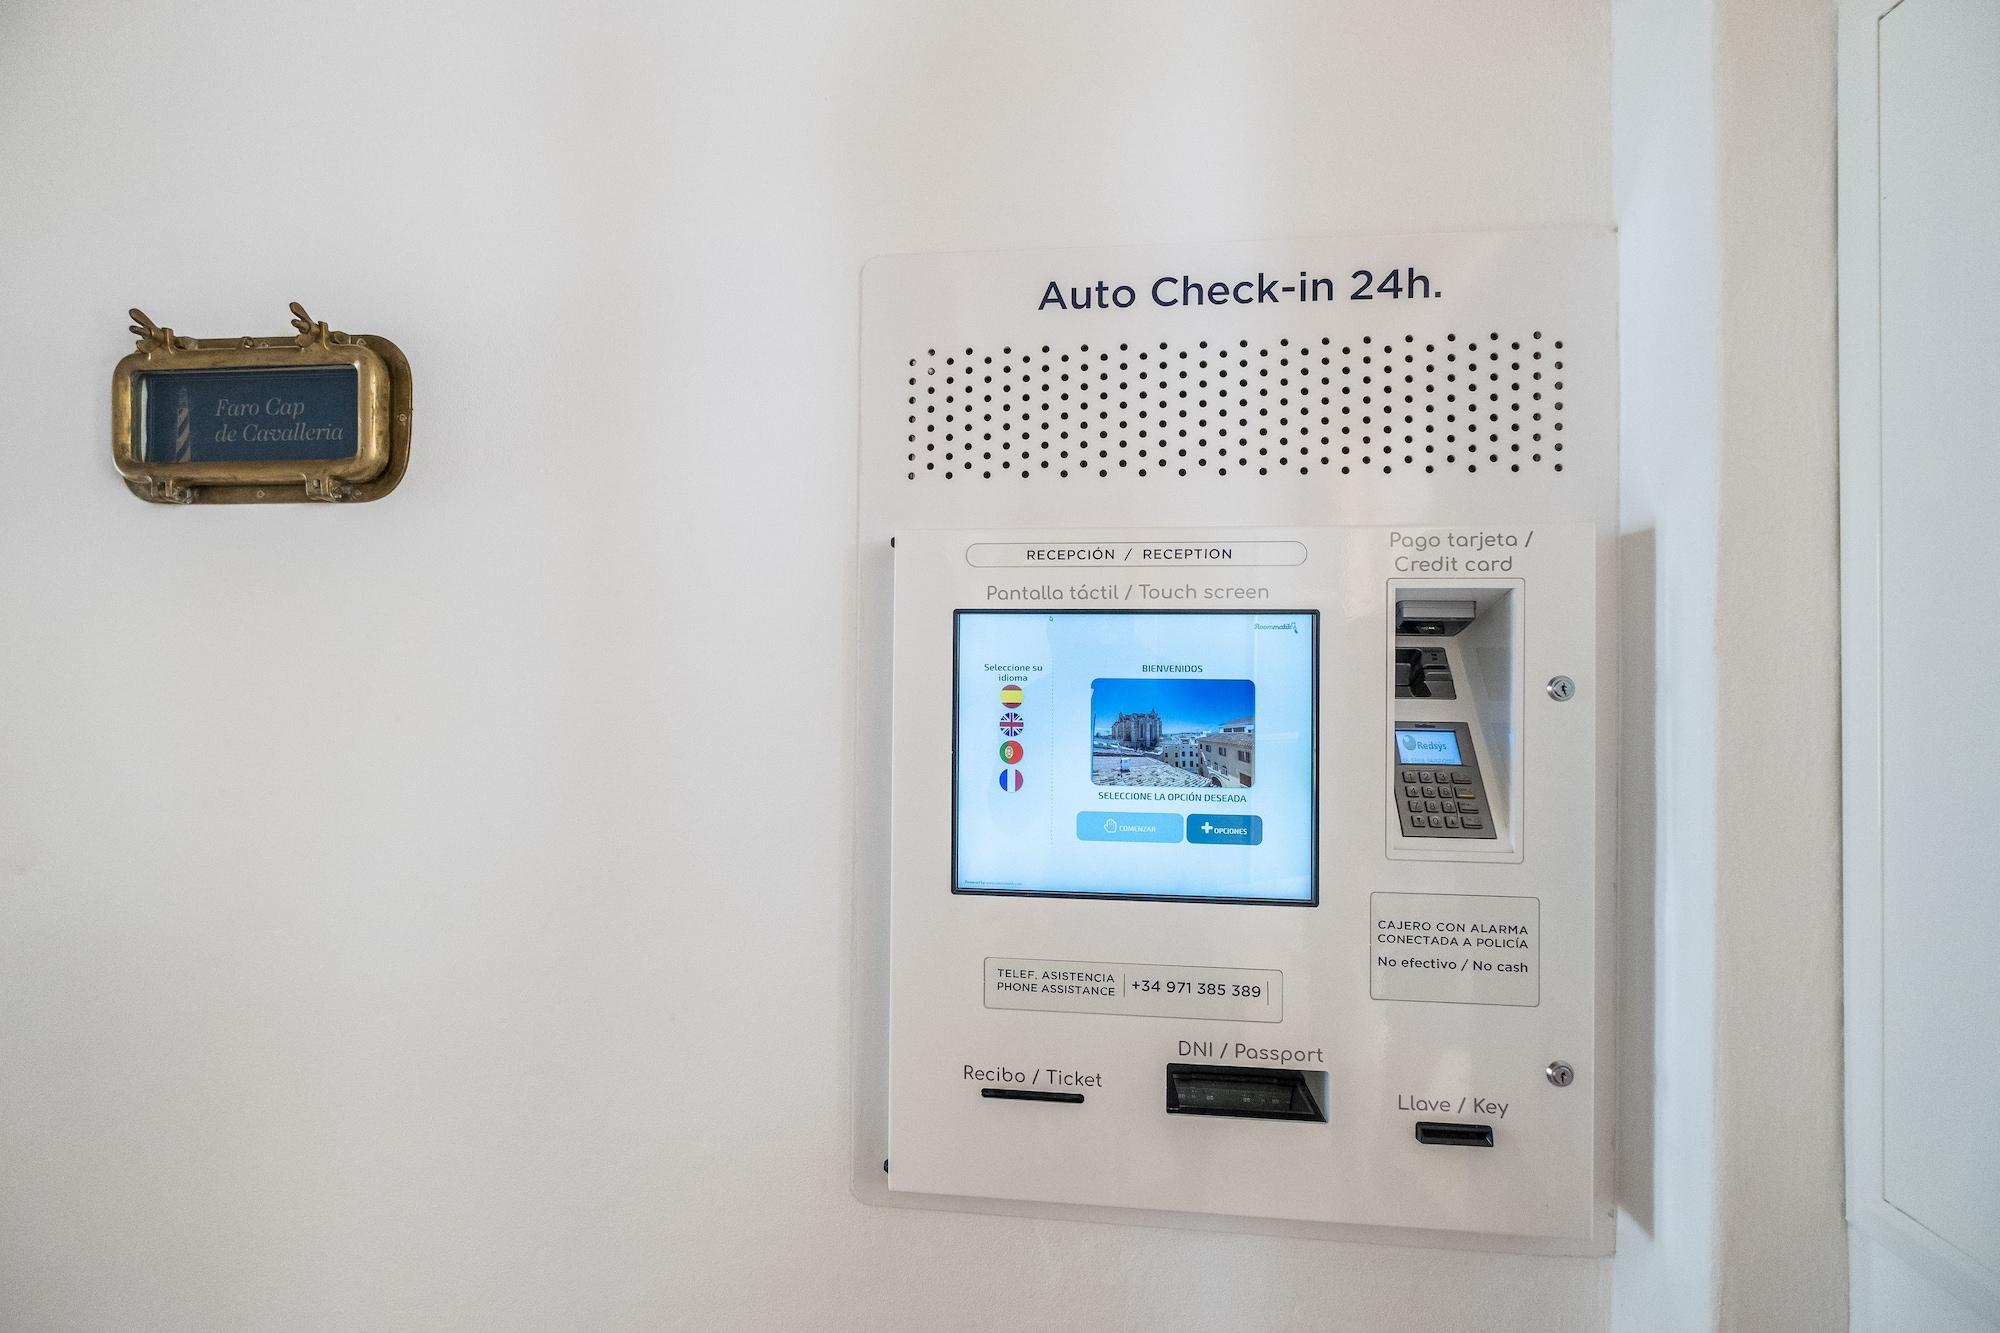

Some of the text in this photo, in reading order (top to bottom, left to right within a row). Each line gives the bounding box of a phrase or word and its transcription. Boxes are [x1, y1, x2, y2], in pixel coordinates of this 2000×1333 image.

[1038, 267, 1442, 310] Auto Check-in 24h.
[215, 397, 304, 419] Faro Cap
[215, 423, 344, 442] de Cavalleria
[1390, 532, 1440, 550] Pago
[1448, 532, 1518, 550] tarjeta
[1026, 547, 1115, 561] RECEPCIÓN
[1143, 548, 1233, 560] RECEPTION
[1395, 556, 1513, 572] Credit card
[987, 585, 1063, 601] Pantalla
[1070, 584, 1118, 600] táctil
[1138, 584, 1197, 600] Touch
[1204, 586, 1270, 600] screen
[984, 663, 1043, 673] Seleccione su
[1142, 664, 1203, 674] BIENVENIDOS
[998, 673, 1028, 682] idioma
[1417, 741, 1447, 752] Redsys
[1098, 791, 1247, 803] SELECCIONE LA OPCIÓN DESEADA
[1118, 824, 1156, 833] COMENZAR
[1213, 827, 1248, 836] OPCIONES
[1378, 920, 1528, 935] CAJERO CON ALARMA
[1377, 934, 1528, 949] CONECTADA A POLICÍA
[1378, 956, 1397, 967] No
[1401, 957, 1457, 970] efectivo
[1473, 960, 1492, 972] No
[1497, 961, 1528, 973] cash
[997, 968, 1115, 983] TELEF. ASISTENCIA
[997, 982, 1115, 996] PHONE ASSISTANCE
[1132, 980, 1262, 998] +34 971 385 389
[1178, 1040, 1213, 1057] DNI
[1235, 1043, 1324, 1065] Passport
[963, 1065, 1026, 1083] Recibo
[1046, 1069, 1103, 1087] Ticket
[1398, 1094, 1451, 1112] Llave
[1473, 1097, 1509, 1119] Key
